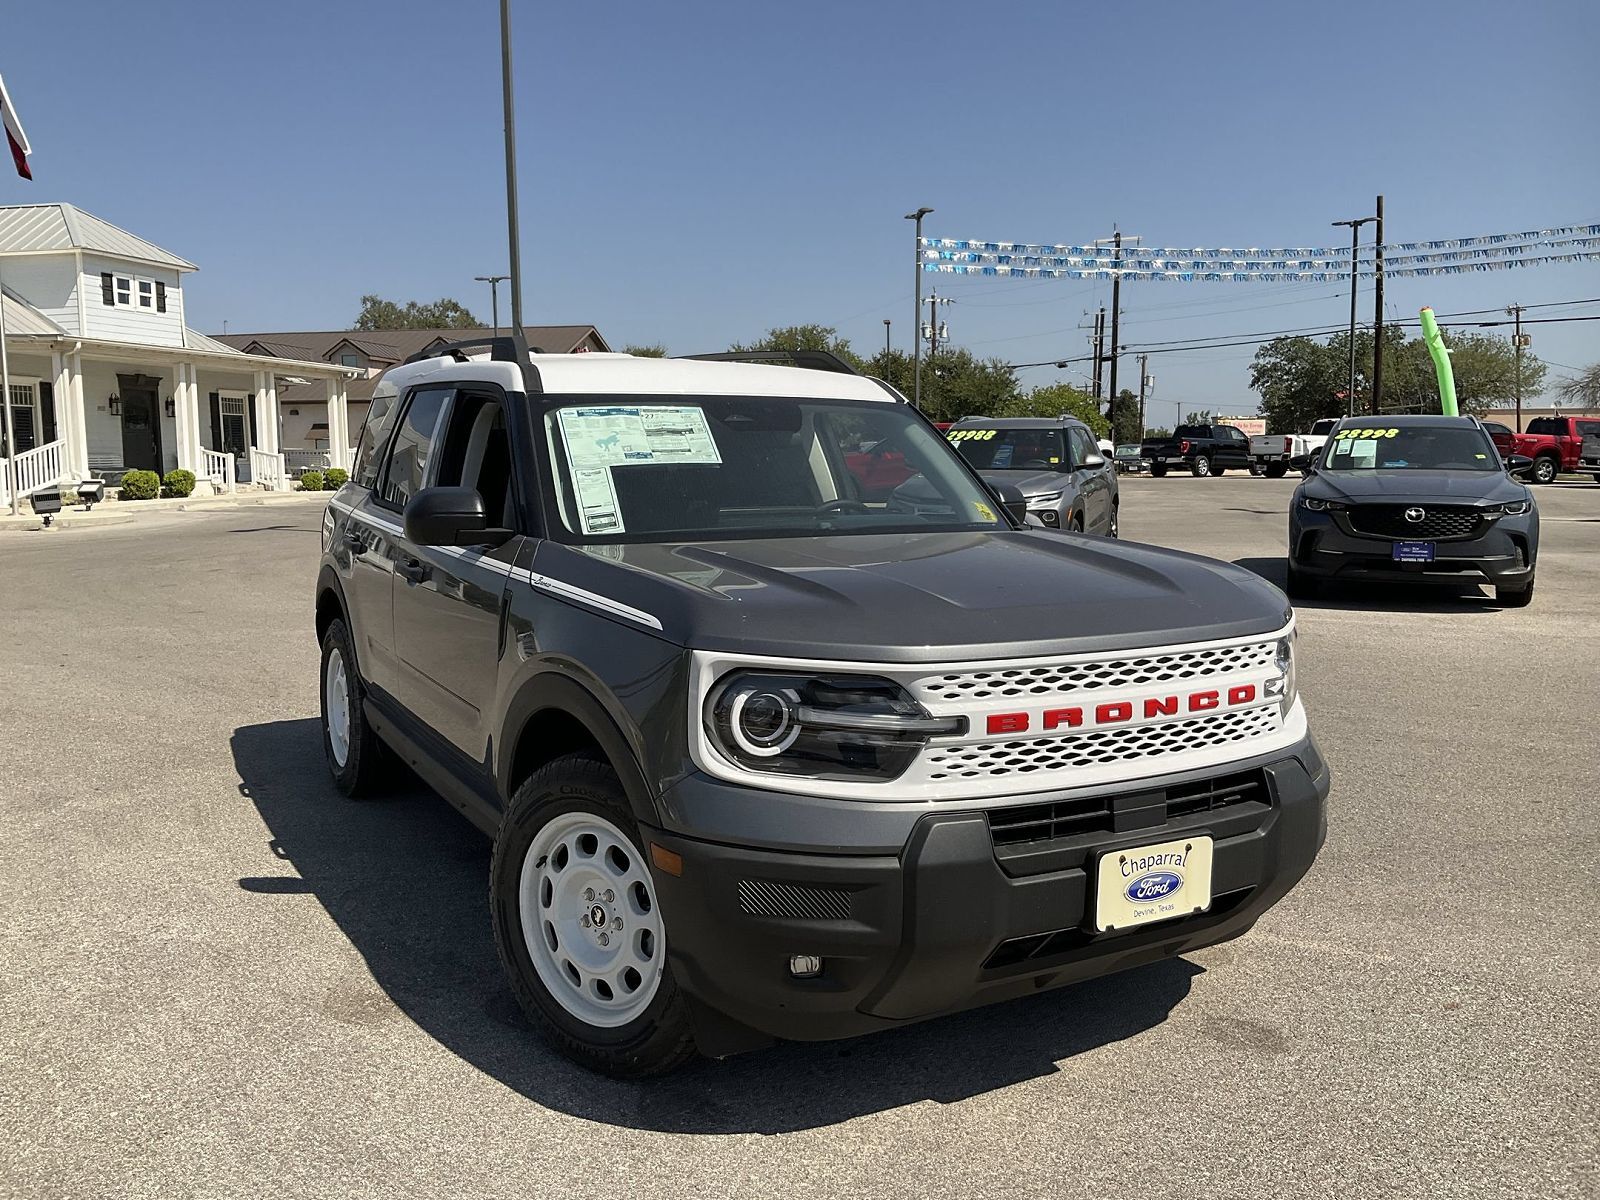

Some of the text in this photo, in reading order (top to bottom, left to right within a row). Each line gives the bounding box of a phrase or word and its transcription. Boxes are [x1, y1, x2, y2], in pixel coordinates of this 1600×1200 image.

[946, 430, 998, 441] 29988
[1334, 428, 1400, 440] 28998
[986, 684, 1256, 735] BRONCO
[1120, 851, 1187, 878] Chaparral
[1137, 876, 1170, 898] Ford
[1133, 903, 1175, 918] Devine, Texas
